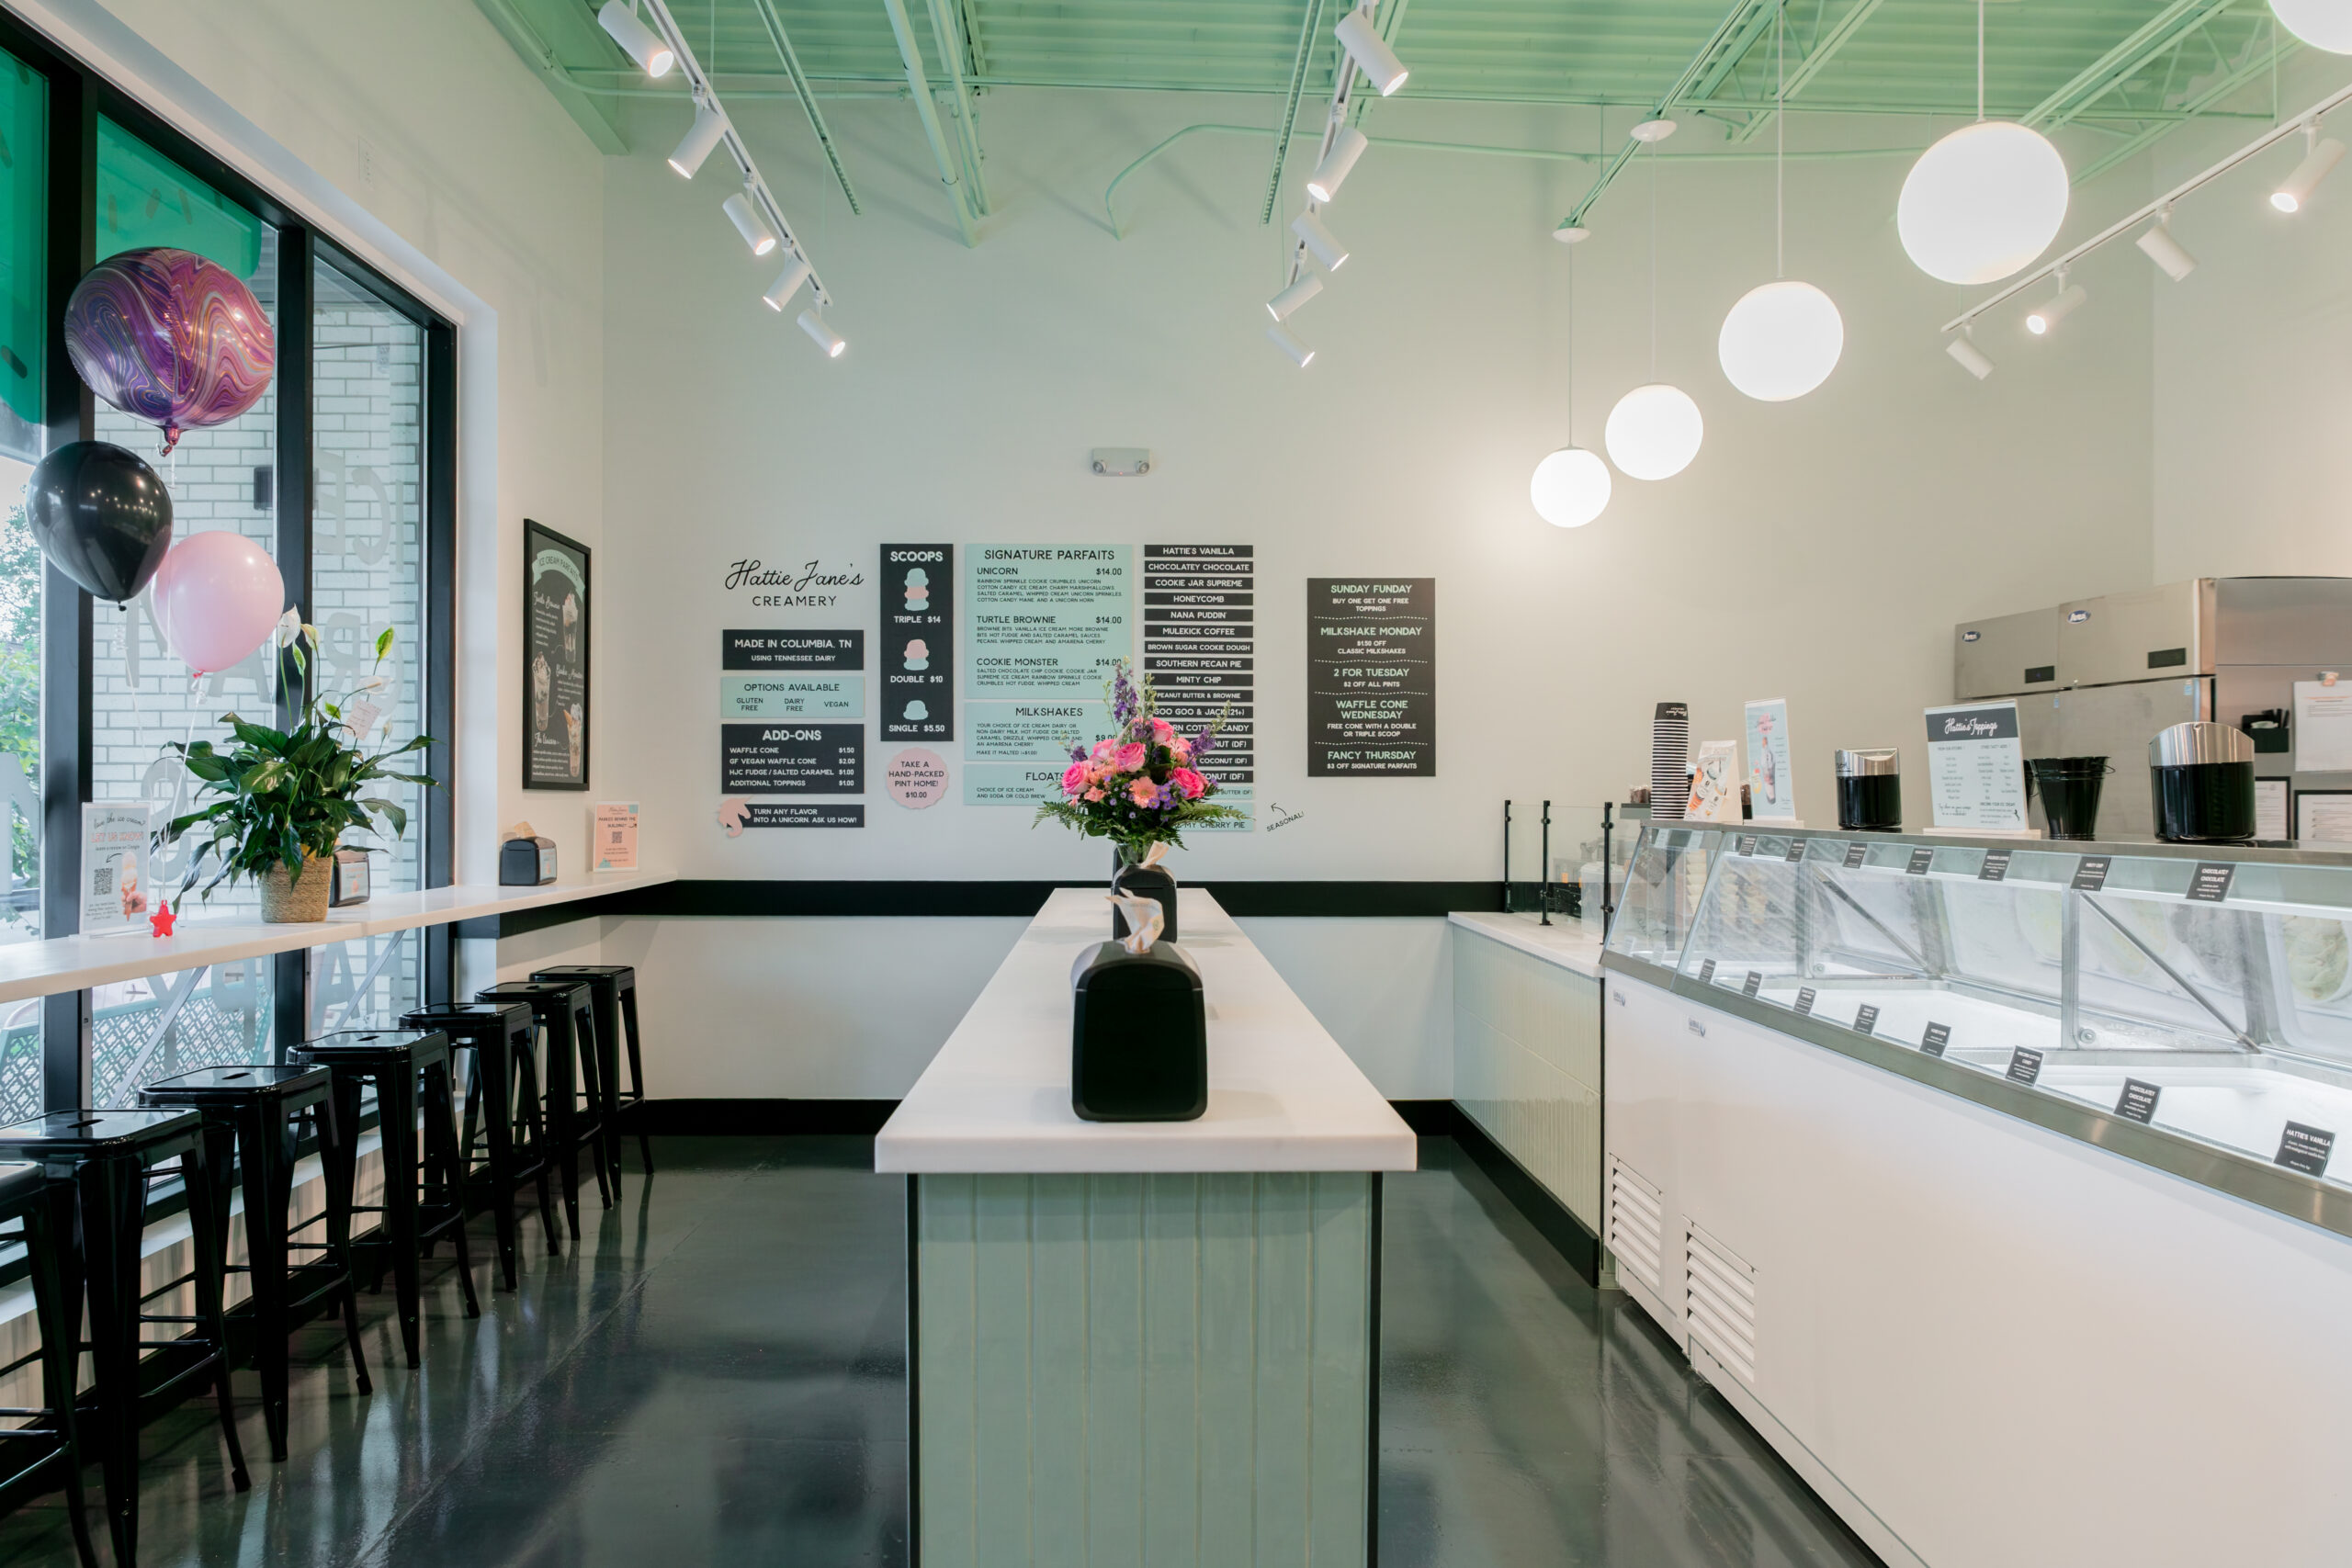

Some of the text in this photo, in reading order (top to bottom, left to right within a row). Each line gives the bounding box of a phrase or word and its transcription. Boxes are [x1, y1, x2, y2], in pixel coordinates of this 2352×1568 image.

[890, 551, 943, 562] SCOOPS
[985, 550, 1114, 559] SIGNATURE PARFAITS
[725, 559, 864, 592] Hattie Jane's
[1096, 568, 1122, 576] $14.00
[1331, 585, 1412, 593] SUNDAY FUNDAY
[752, 596, 836, 606] CREAMERY
[931, 675, 943, 683] $10
[763, 730, 821, 740] ADD-ONS
[1267, 811, 1304, 831] SEASONAL!
